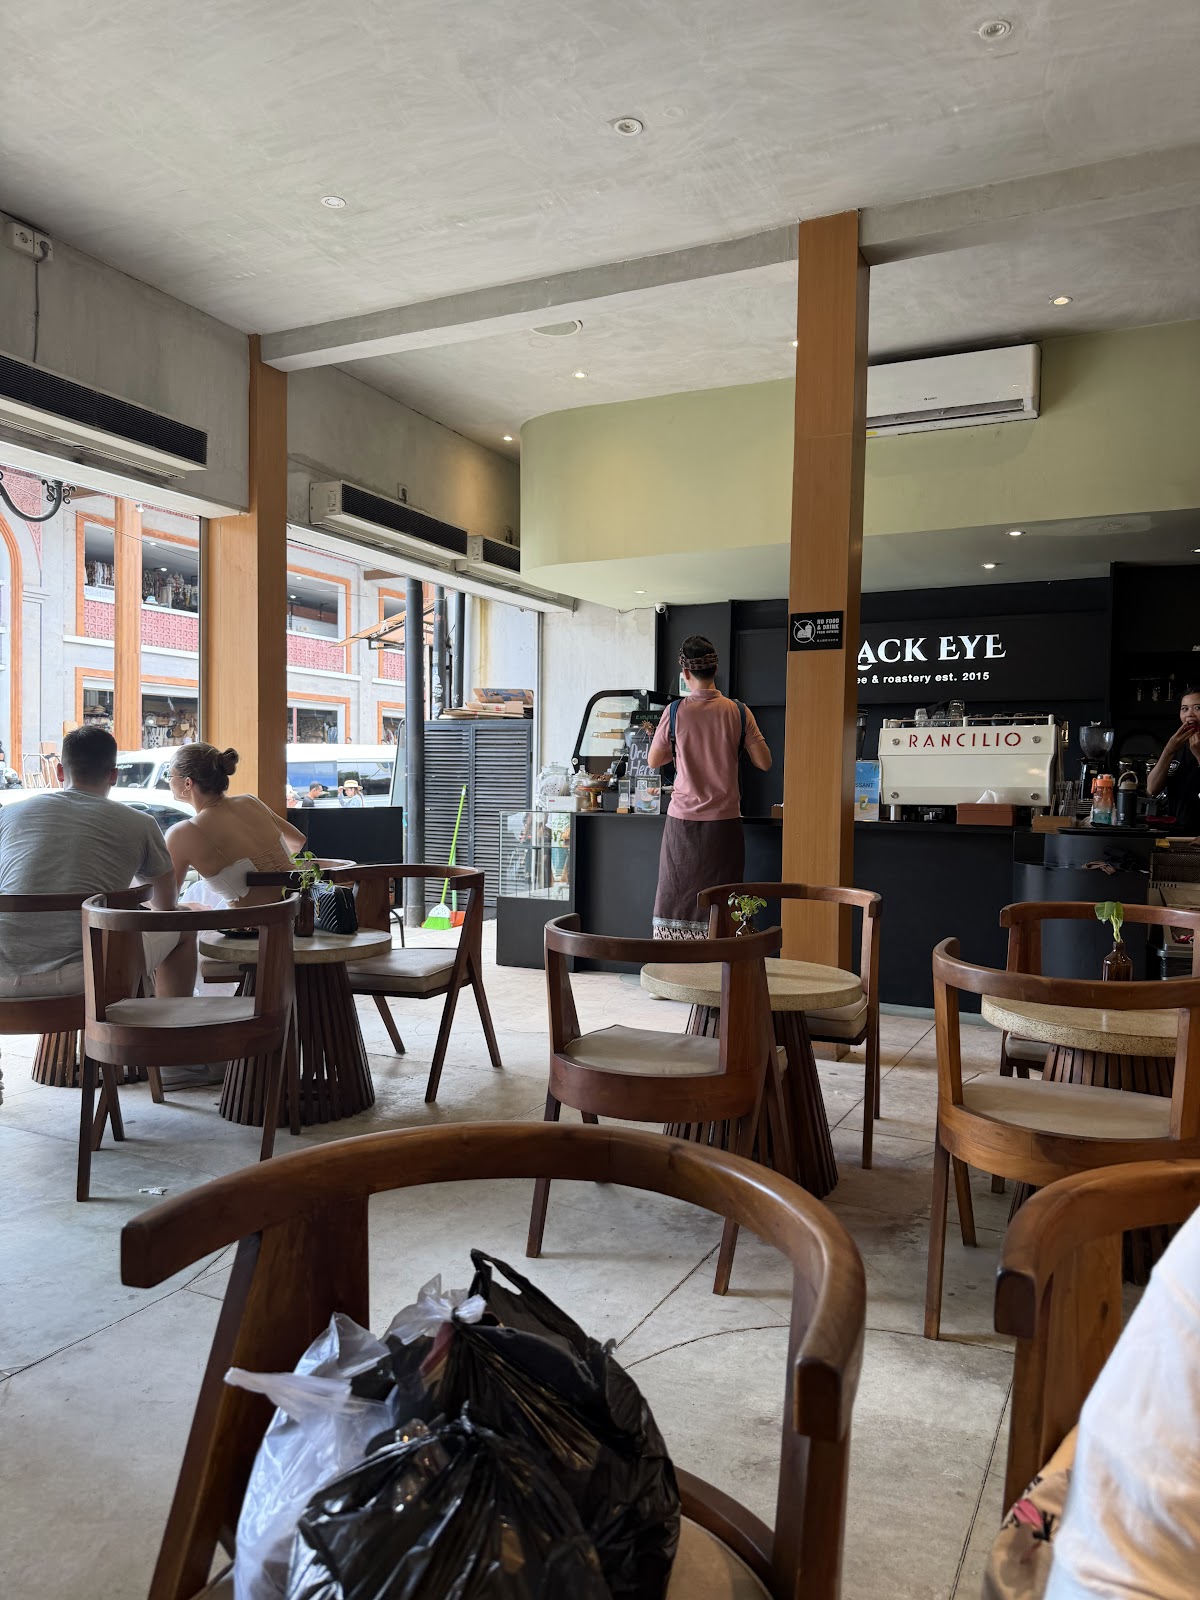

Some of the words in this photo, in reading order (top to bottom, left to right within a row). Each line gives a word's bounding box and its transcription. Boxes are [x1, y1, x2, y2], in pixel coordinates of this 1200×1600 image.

[857, 637, 928, 670] ACK
[937, 633, 1007, 661] EYE
[871, 674, 879, 684] &
[883, 673, 931, 684] roastery
[935, 672, 958, 682] est.
[962, 671, 990, 681] 2015
[908, 732, 1021, 748] RANCILIO
[630, 743, 649, 760] Ord
